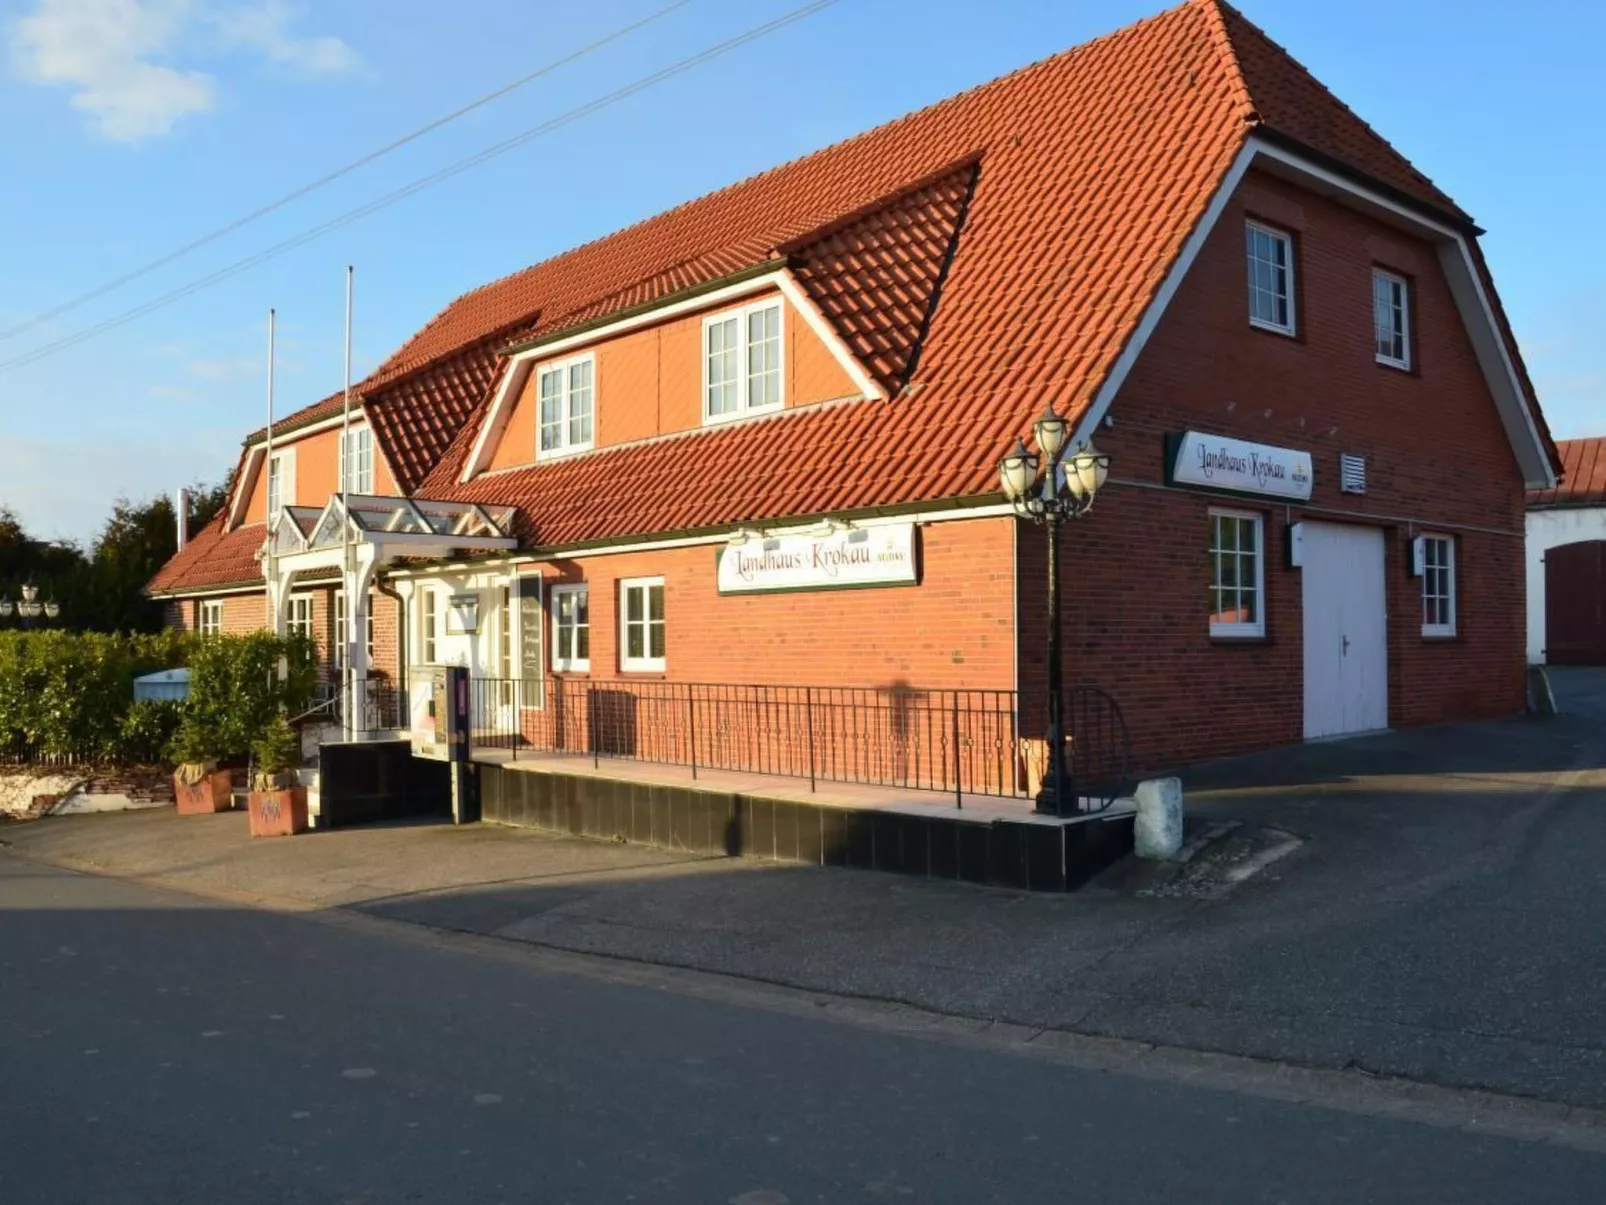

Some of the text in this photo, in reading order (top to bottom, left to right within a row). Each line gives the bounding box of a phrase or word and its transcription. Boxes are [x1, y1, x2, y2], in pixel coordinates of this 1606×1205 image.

[1198, 443, 1285, 487] Landhaus Krokau
[733, 543, 871, 581] Landhaus Krokau
